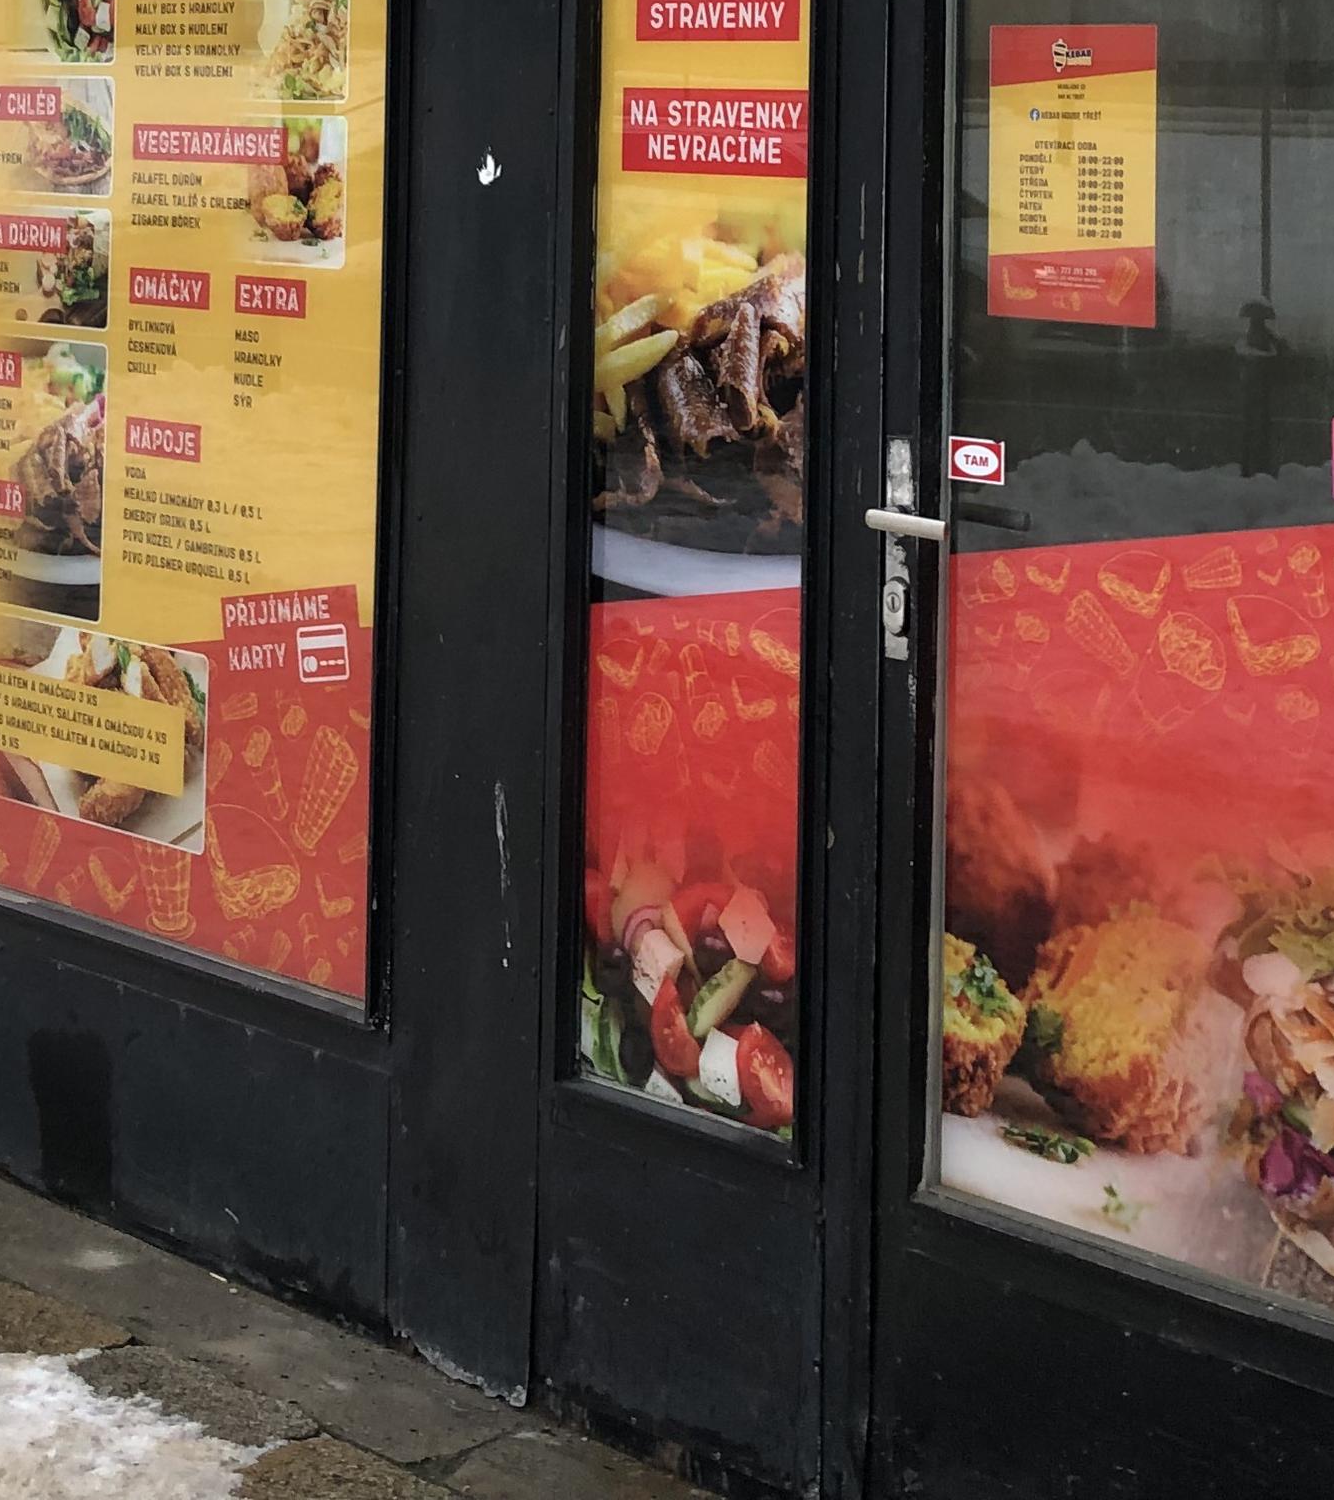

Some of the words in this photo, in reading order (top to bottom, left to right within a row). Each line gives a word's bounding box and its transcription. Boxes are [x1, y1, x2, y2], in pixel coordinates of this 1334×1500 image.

[160, 2, 177, 14] BOX
[180, 2, 186, 14] S
[188, 1, 235, 14] HRANOLKY
[650, 2, 786, 30] STRAVENKY
[160, 23, 177, 35] BOX
[179, 23, 186, 35] S
[188, 23, 228, 35] NUDLEMI
[165, 44, 182, 56] BOX
[185, 44, 191, 57] S
[194, 45, 241, 57] HRANOLKY
[165, 65, 182, 77] BOX
[184, 65, 191, 77] S
[7, 88, 56, 116] CHLÉB
[630, 100, 659, 127] NA
[667, 102, 803, 131] STRAVENKY
[137, 127, 282, 158] VEGETARIÁNSKÉ
[647, 129, 782, 165] NEVRACÍME
[132, 172, 169, 185] FALAFEL
[131, 193, 169, 206] FALAFEL
[201, 196, 207, 208] S
[210, 196, 252, 210] CHLEBEM
[8, 220, 62, 248] DÜRÜM
[133, 272, 203, 303] OMÁČKY
[239, 283, 300, 312] EXTRA
[235, 329, 259, 344] MASO
[128, 339, 177, 357] ČESNEKOVÁ
[234, 351, 282, 368] HRANOLKY
[233, 373, 264, 388] NUDLE
[233, 392, 253, 409] SÝR
[129, 421, 196, 456] NÁPOJE
[963, 454, 989, 467] TAM
[224, 502, 229, 515] L
[257, 505, 263, 520] L
[205, 519, 211, 534] L
[224, 592, 330, 628] PŘIJÍMÁME
[228, 642, 286, 672] KARTY
